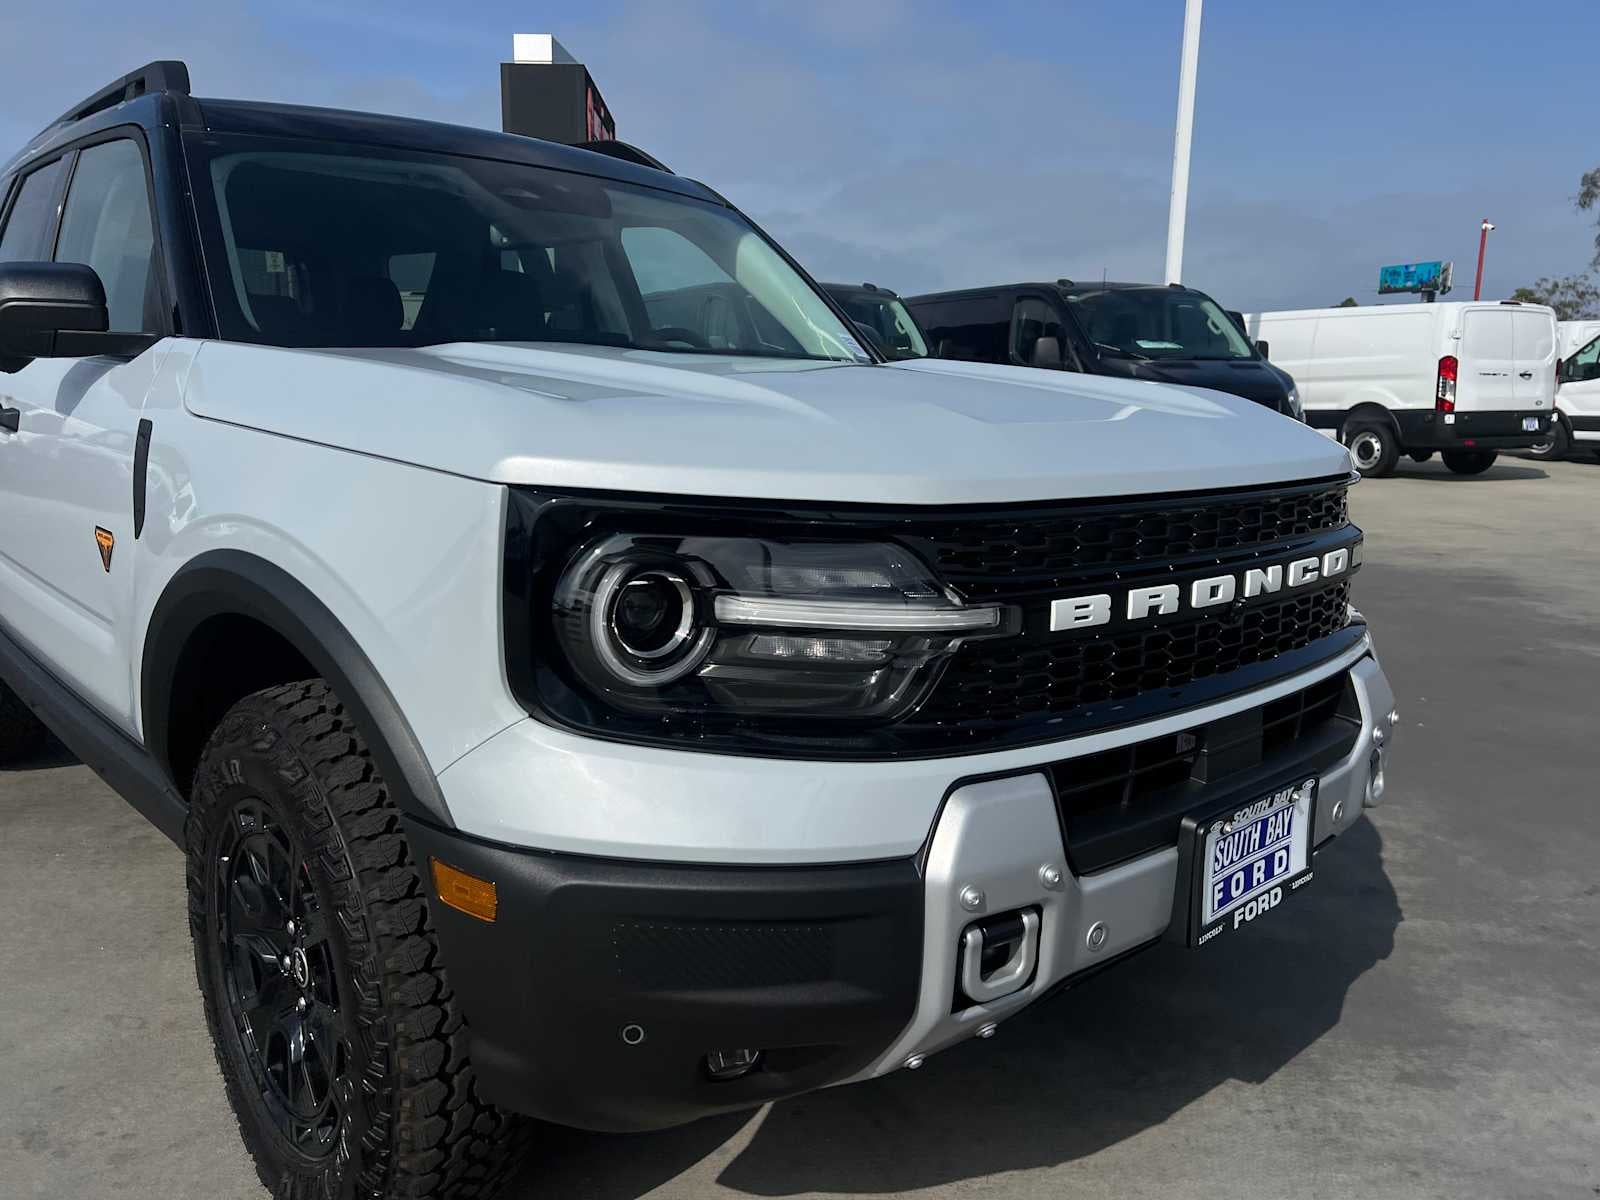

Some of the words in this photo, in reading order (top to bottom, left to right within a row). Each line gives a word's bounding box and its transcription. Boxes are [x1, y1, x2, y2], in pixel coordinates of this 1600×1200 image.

[1050, 548, 1348, 631] BRONCO
[1233, 797, 1271, 823] SOUTH
[1273, 787, 1295, 807] BAY
[1214, 821, 1262, 872] SOUTH
[1265, 806, 1293, 846] BAY
[1213, 849, 1288, 911] FORD
[1233, 886, 1282, 930] FORD
[1199, 925, 1223, 945] LINCOLN
